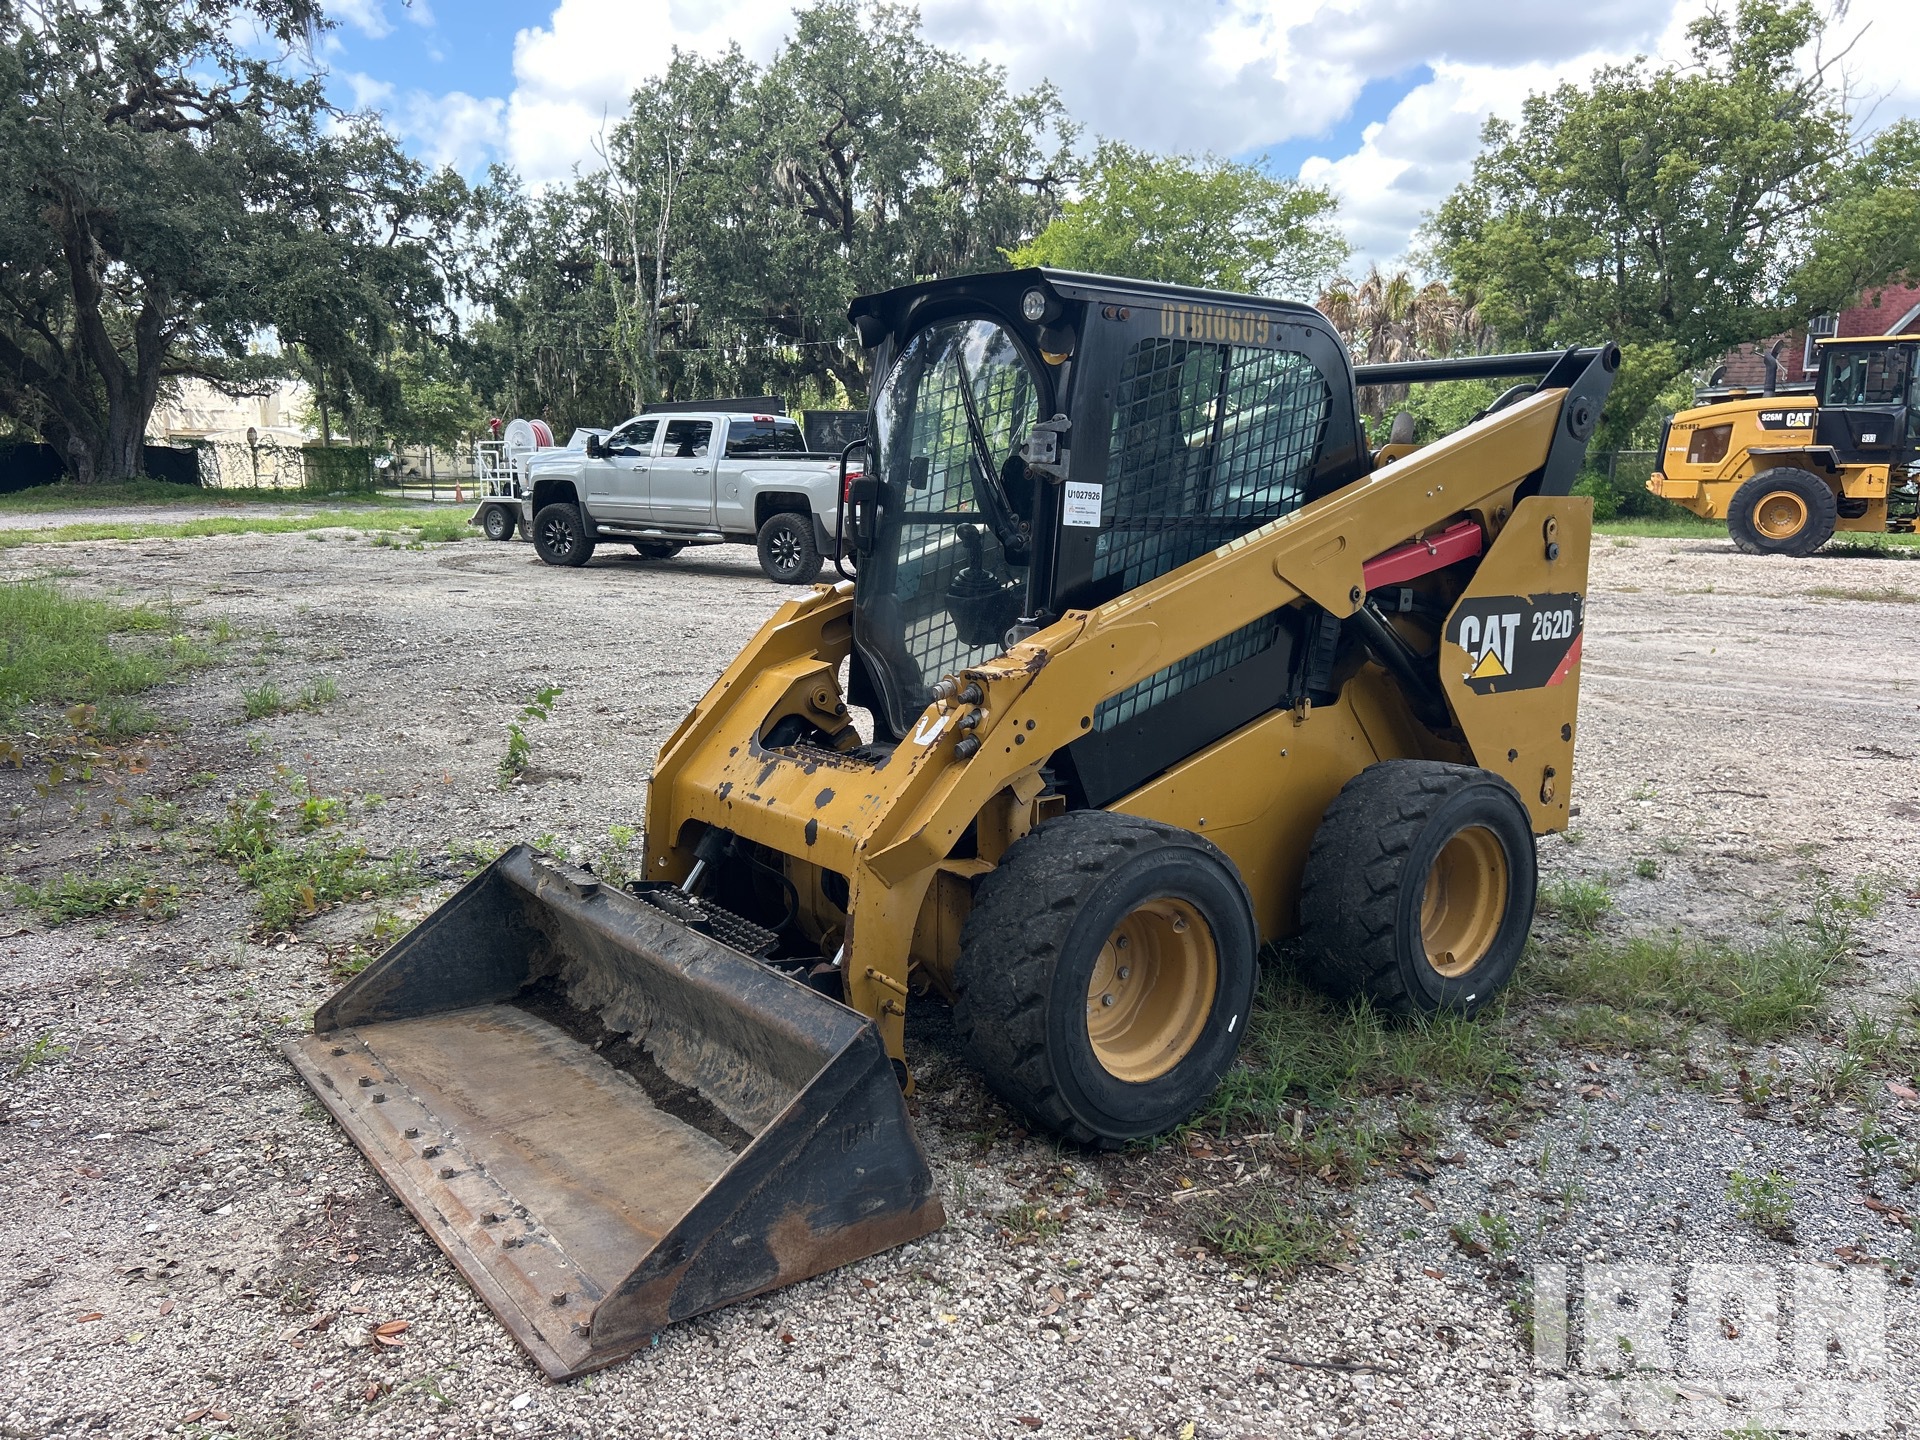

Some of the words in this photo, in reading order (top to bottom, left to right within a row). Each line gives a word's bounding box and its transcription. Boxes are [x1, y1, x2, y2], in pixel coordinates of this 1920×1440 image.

[1761, 413, 1783, 421] 926M
[1786, 412, 1812, 427] CAT
[1067, 489, 1101, 500] U1027926
[1458, 613, 1521, 677] CAT
[1531, 609, 1573, 642] 262D
[841, 1116, 884, 1153] CAT
